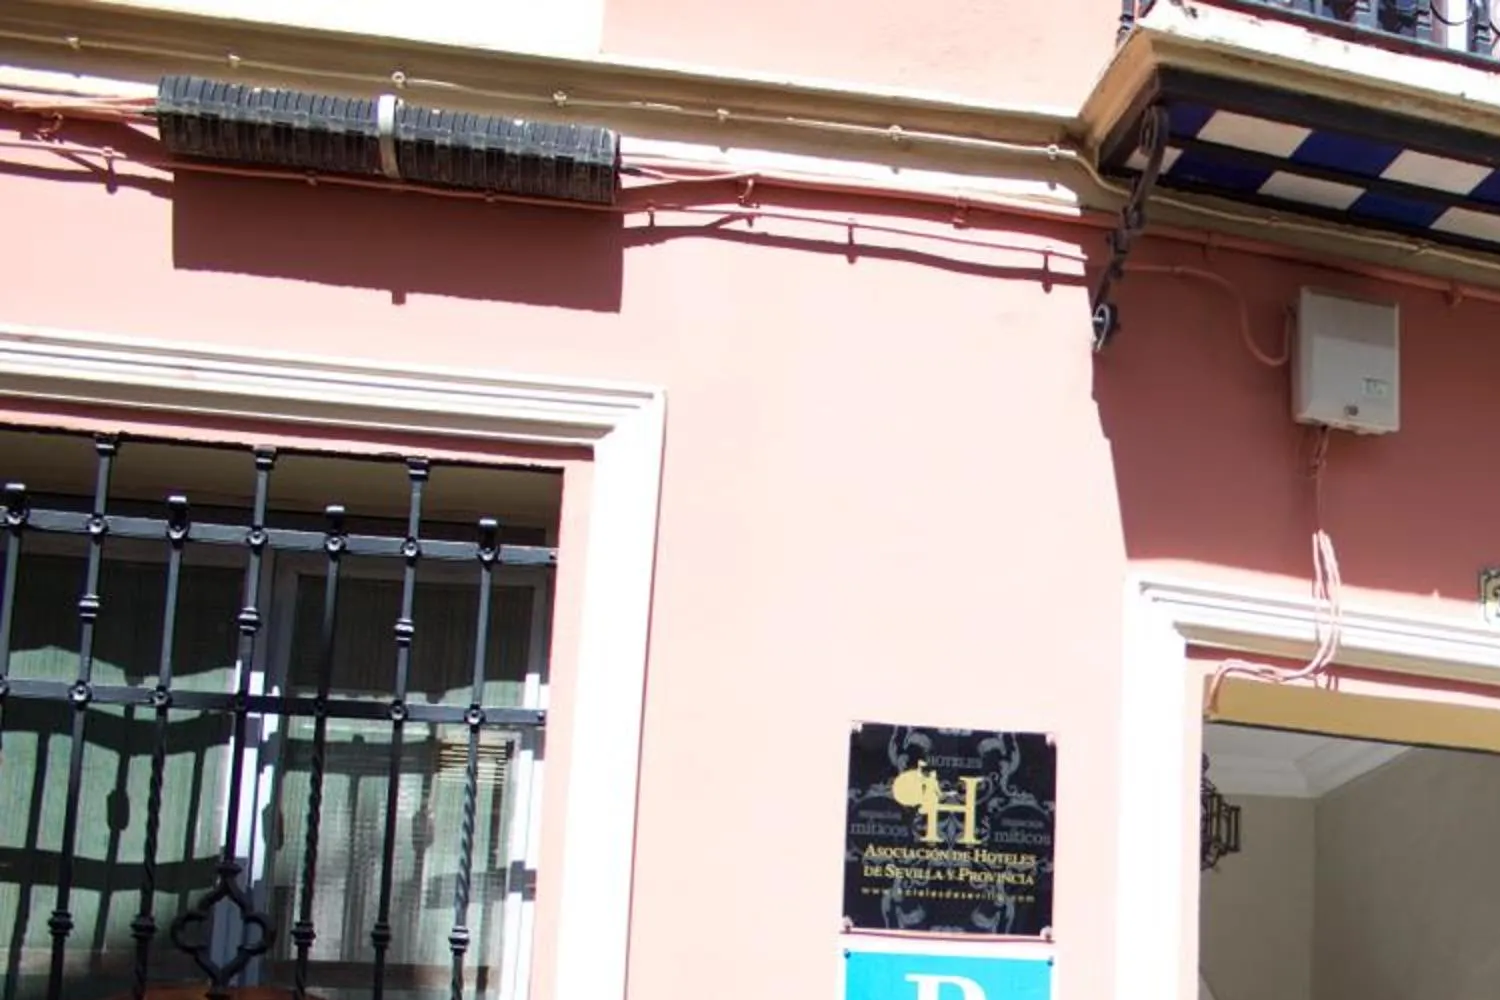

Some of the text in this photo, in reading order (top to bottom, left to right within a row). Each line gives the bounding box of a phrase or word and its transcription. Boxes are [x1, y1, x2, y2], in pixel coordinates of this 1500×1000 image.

[863, 844, 1036, 866] ASOCIACIÓN DE HOTELES
[863, 863, 1034, 886] DE SEVILLA Y PROVINCIA
